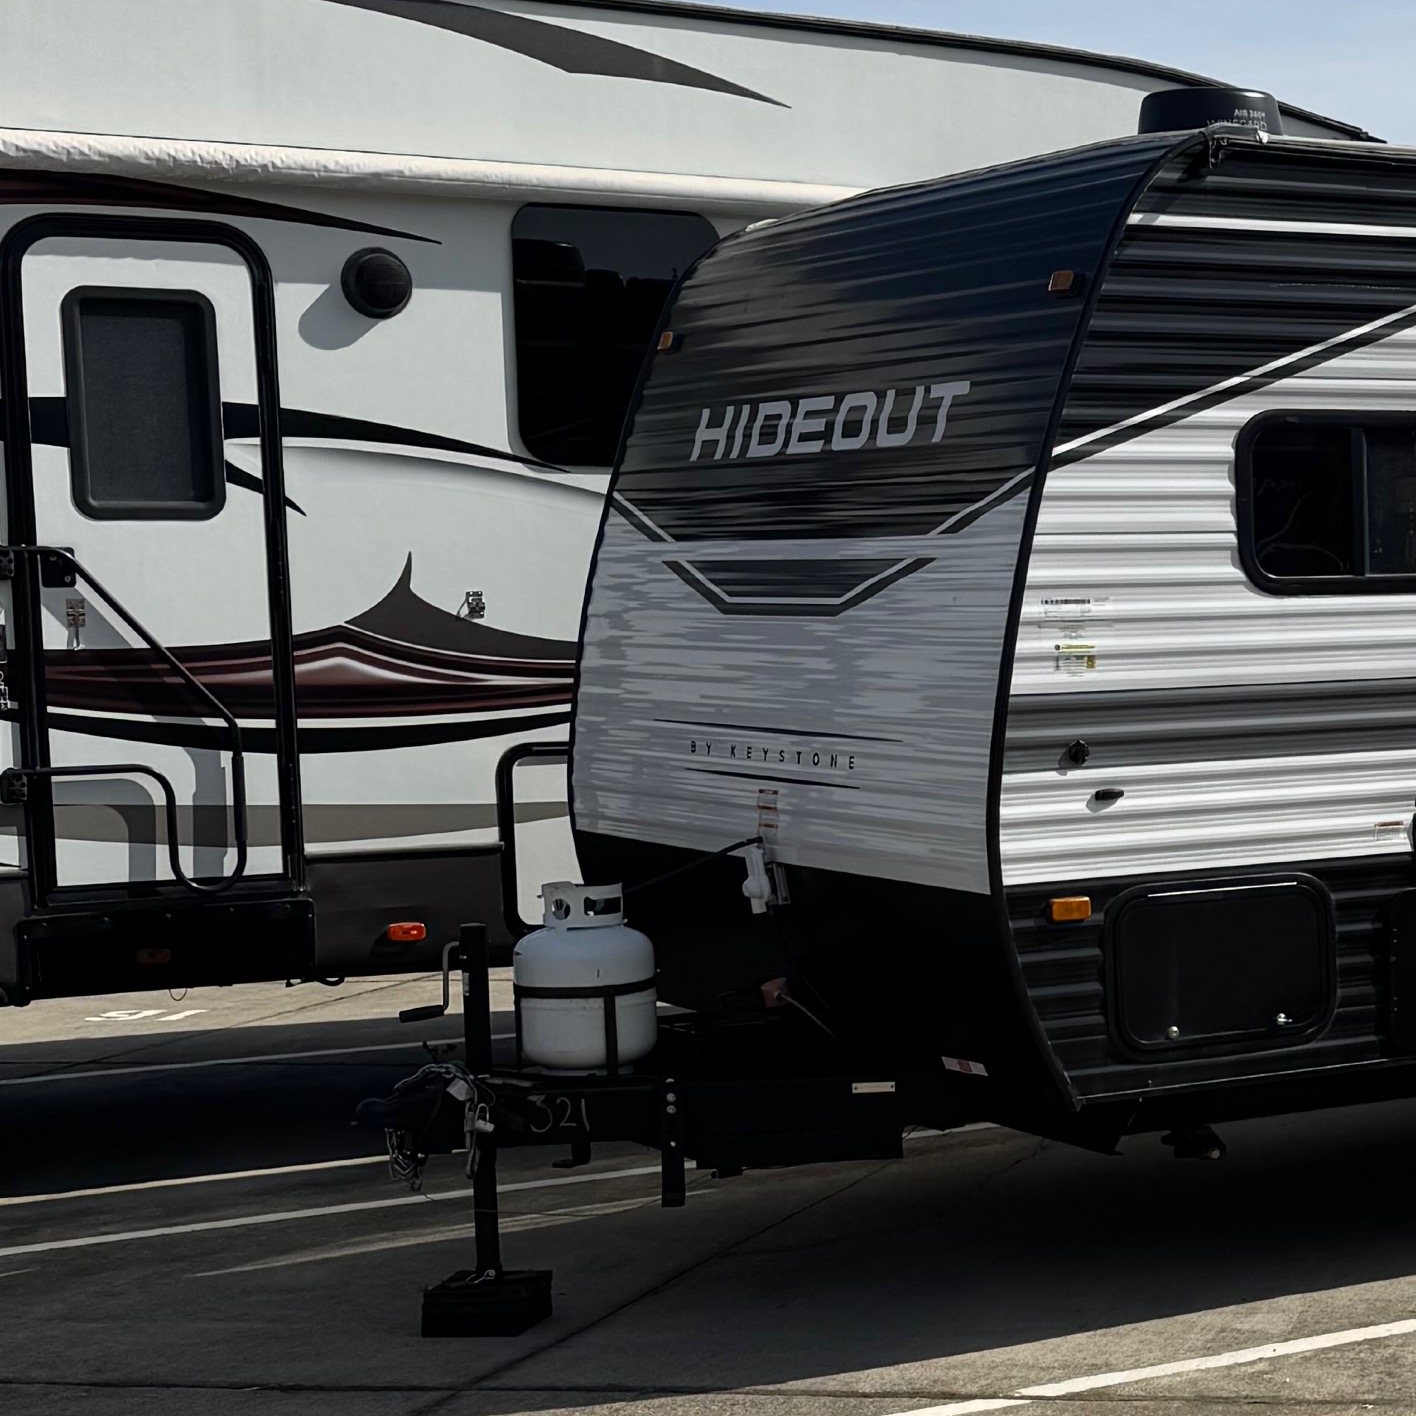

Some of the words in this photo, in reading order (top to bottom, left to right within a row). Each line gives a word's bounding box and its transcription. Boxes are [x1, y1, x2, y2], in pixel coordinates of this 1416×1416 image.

[690, 380, 971, 461] HIDEOUT
[690, 740, 712, 756] BY
[730, 743, 857, 770] KEYSTONE
[526, 1093, 591, 1134] 321
